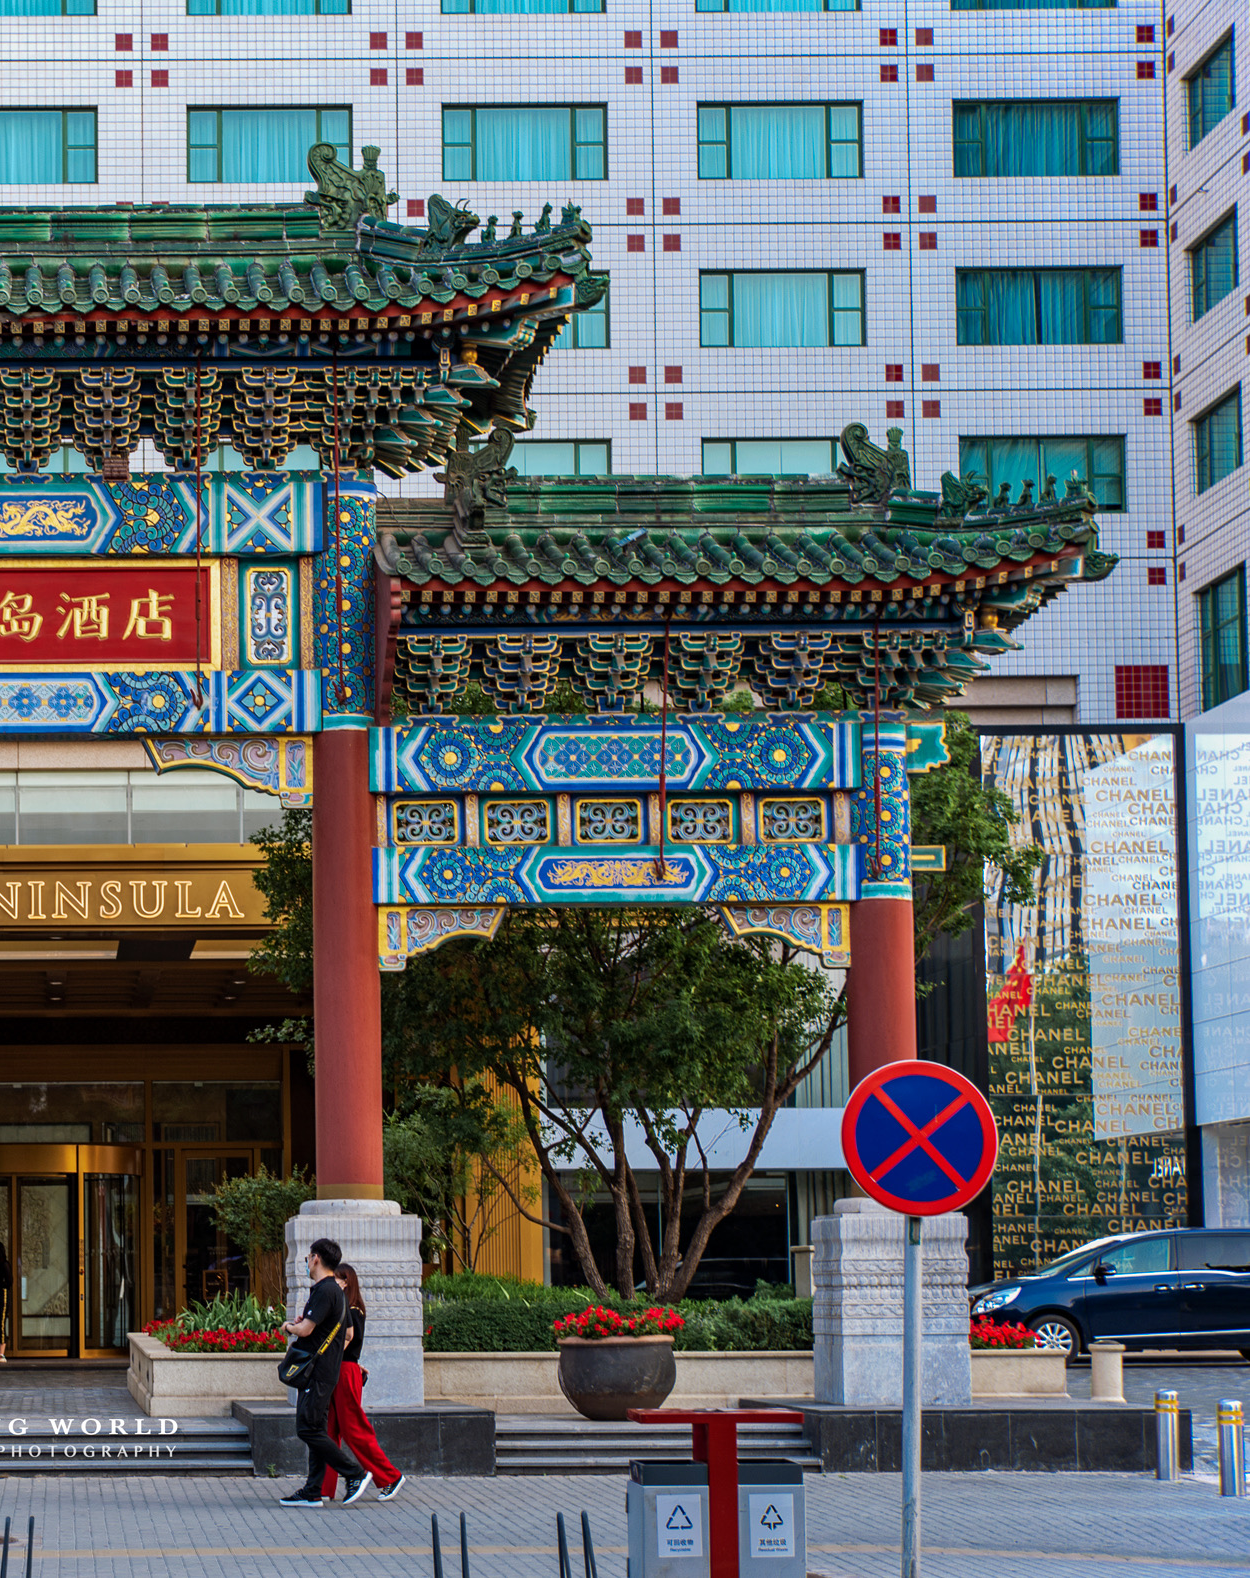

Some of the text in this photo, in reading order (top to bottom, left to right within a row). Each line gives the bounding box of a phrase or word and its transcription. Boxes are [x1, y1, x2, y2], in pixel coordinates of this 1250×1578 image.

[1075, 743, 1124, 752] CHANE
[995, 777, 1070, 789] CHANEL
[1081, 777, 1137, 786] CHANEL
[1029, 794, 1091, 805] CHANEL
[1095, 789, 1174, 802] CHANEL
[1020, 810, 1081, 822] HANEL
[1092, 811, 1125, 819] CHANEL
[1086, 820, 1129, 828] CHANEL
[1090, 840, 1169, 853] CHANEL
[1064, 857, 1119, 866] CHANEL
[1117, 856, 1161, 864] CHANEL
[1034, 875, 1094, 888] HANEL
[1111, 874, 1154, 882] CHANEL
[1083, 893, 1162, 906] CHANEL
[1123, 907, 1168, 915] CHANEL
[1079, 918, 1156, 930] CHANEL
[1067, 931, 1111, 939] CHANEL
[988, 936, 1065, 948] CHANEL
[1122, 939, 1167, 947] CHANEL
[1070, 944, 1123, 953] CHANEL
[1102, 955, 1147, 963] CHANEL
[1021, 959, 1085, 970] CHANEL
[1030, 974, 1106, 987] CHANEL
[1104, 974, 1148, 982] CHANEL
[1026, 987, 1071, 995] CHANEL
[1101, 993, 1180, 1006] CHANEL
[1055, 1001, 1098, 1010] CHANEL
[1076, 1009, 1131, 1019] CHANEL
[1007, 1028, 1085, 1041] CHANEL
[1128, 1027, 1181, 1037] CHANE
[1117, 1038, 1161, 1046] CHANEL
[1063, 1046, 1107, 1055] CHANEL
[1052, 1056, 1130, 1069] CHANEL
[1005, 1071, 1084, 1084] CHANEL
[1090, 1072, 1132, 1080] CHANEL
[1076, 1094, 1117, 1102] CHANEL
[1130, 1094, 1174, 1102] CHANEL
[1013, 1104, 1058, 1112] CHANEL
[1096, 1103, 1175, 1116] CHANEL
[994, 1116, 1055, 1126] CHANEL
[1055, 1120, 1132, 1133] CHANEL
[1000, 1133, 1052, 1146] ANEL
[1107, 1136, 1170, 1147] CHANEL
[1009, 1147, 1064, 1156] CHANEL
[1076, 1152, 1154, 1165] CHANEL
[1007, 1180, 1085, 1193] CHANEL
[1095, 1180, 1139, 1188] CHANEL
[1148, 1176, 1187, 1189] CHA
[993, 1193, 1034, 1204] ANEL
[1097, 1192, 1160, 1202] CHANEL
[1164, 1192, 1188, 1205] CH
[1063, 1203, 1142, 1216] CHANEL
[1031, 1240, 1090, 1252] CHAN
